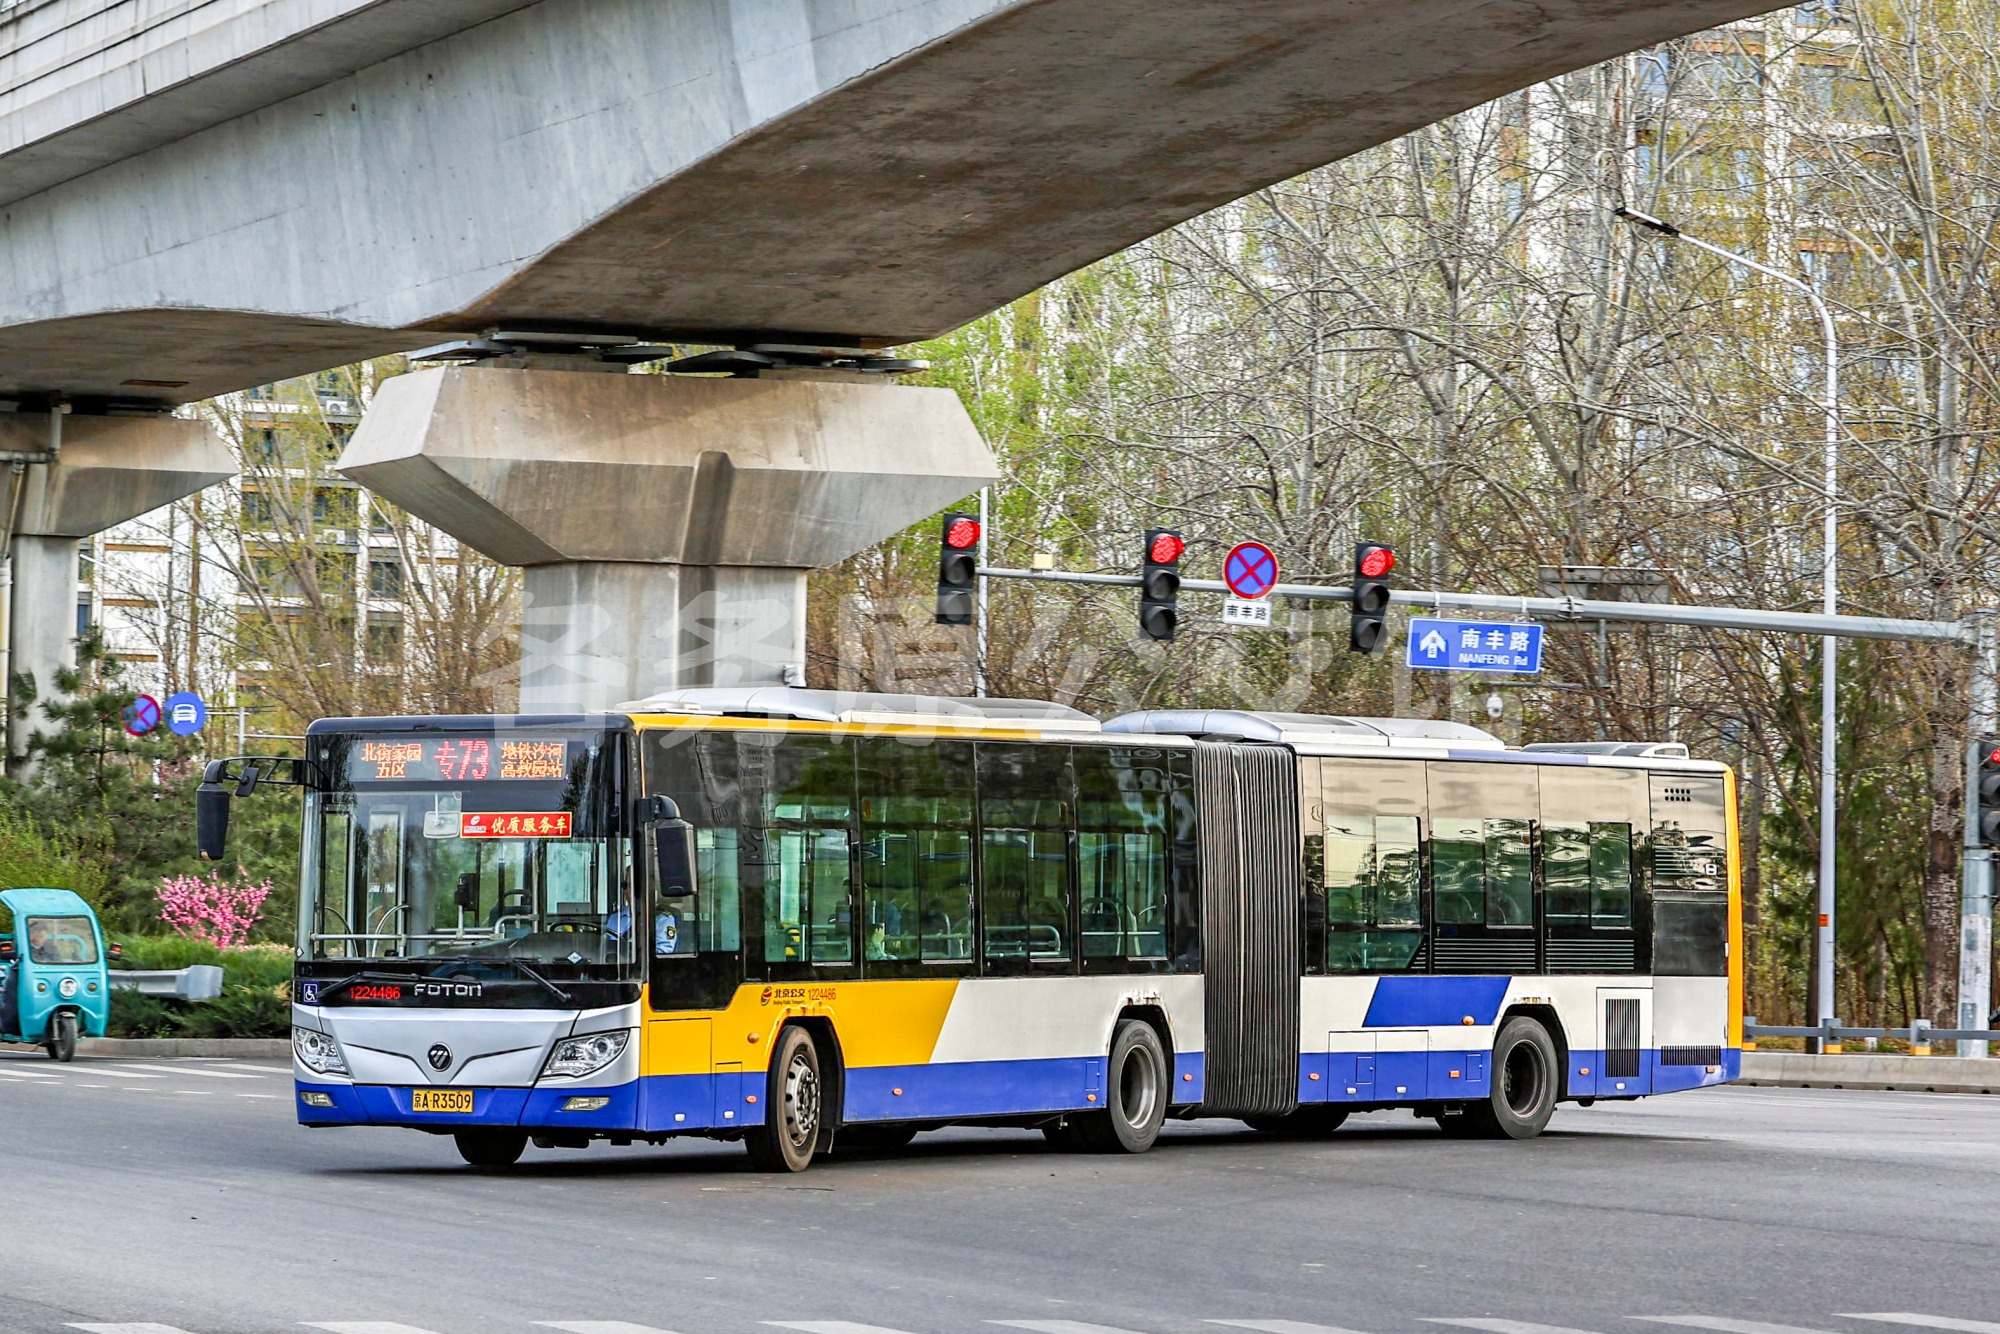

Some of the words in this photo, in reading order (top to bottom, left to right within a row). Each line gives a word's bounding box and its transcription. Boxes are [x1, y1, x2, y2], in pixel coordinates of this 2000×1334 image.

[1226, 604, 1267, 620] 南丰路
[1460, 628, 1530, 652] 南丰路
[1458, 653, 1511, 666] NANFENG
[1513, 656, 1528, 666] Rd
[361, 743, 422, 762] 北街家园
[501, 741, 564, 760] 地铁沙河
[375, 762, 406, 778] 五区
[500, 760, 563, 779] 高教园站
[491, 816, 568, 835] 优质服务车
[350, 986, 401, 1000] 1224486
[414, 983, 482, 997] FOTON
[774, 988, 806, 999] 北京公交
[808, 988, 836, 1001] 1224486
